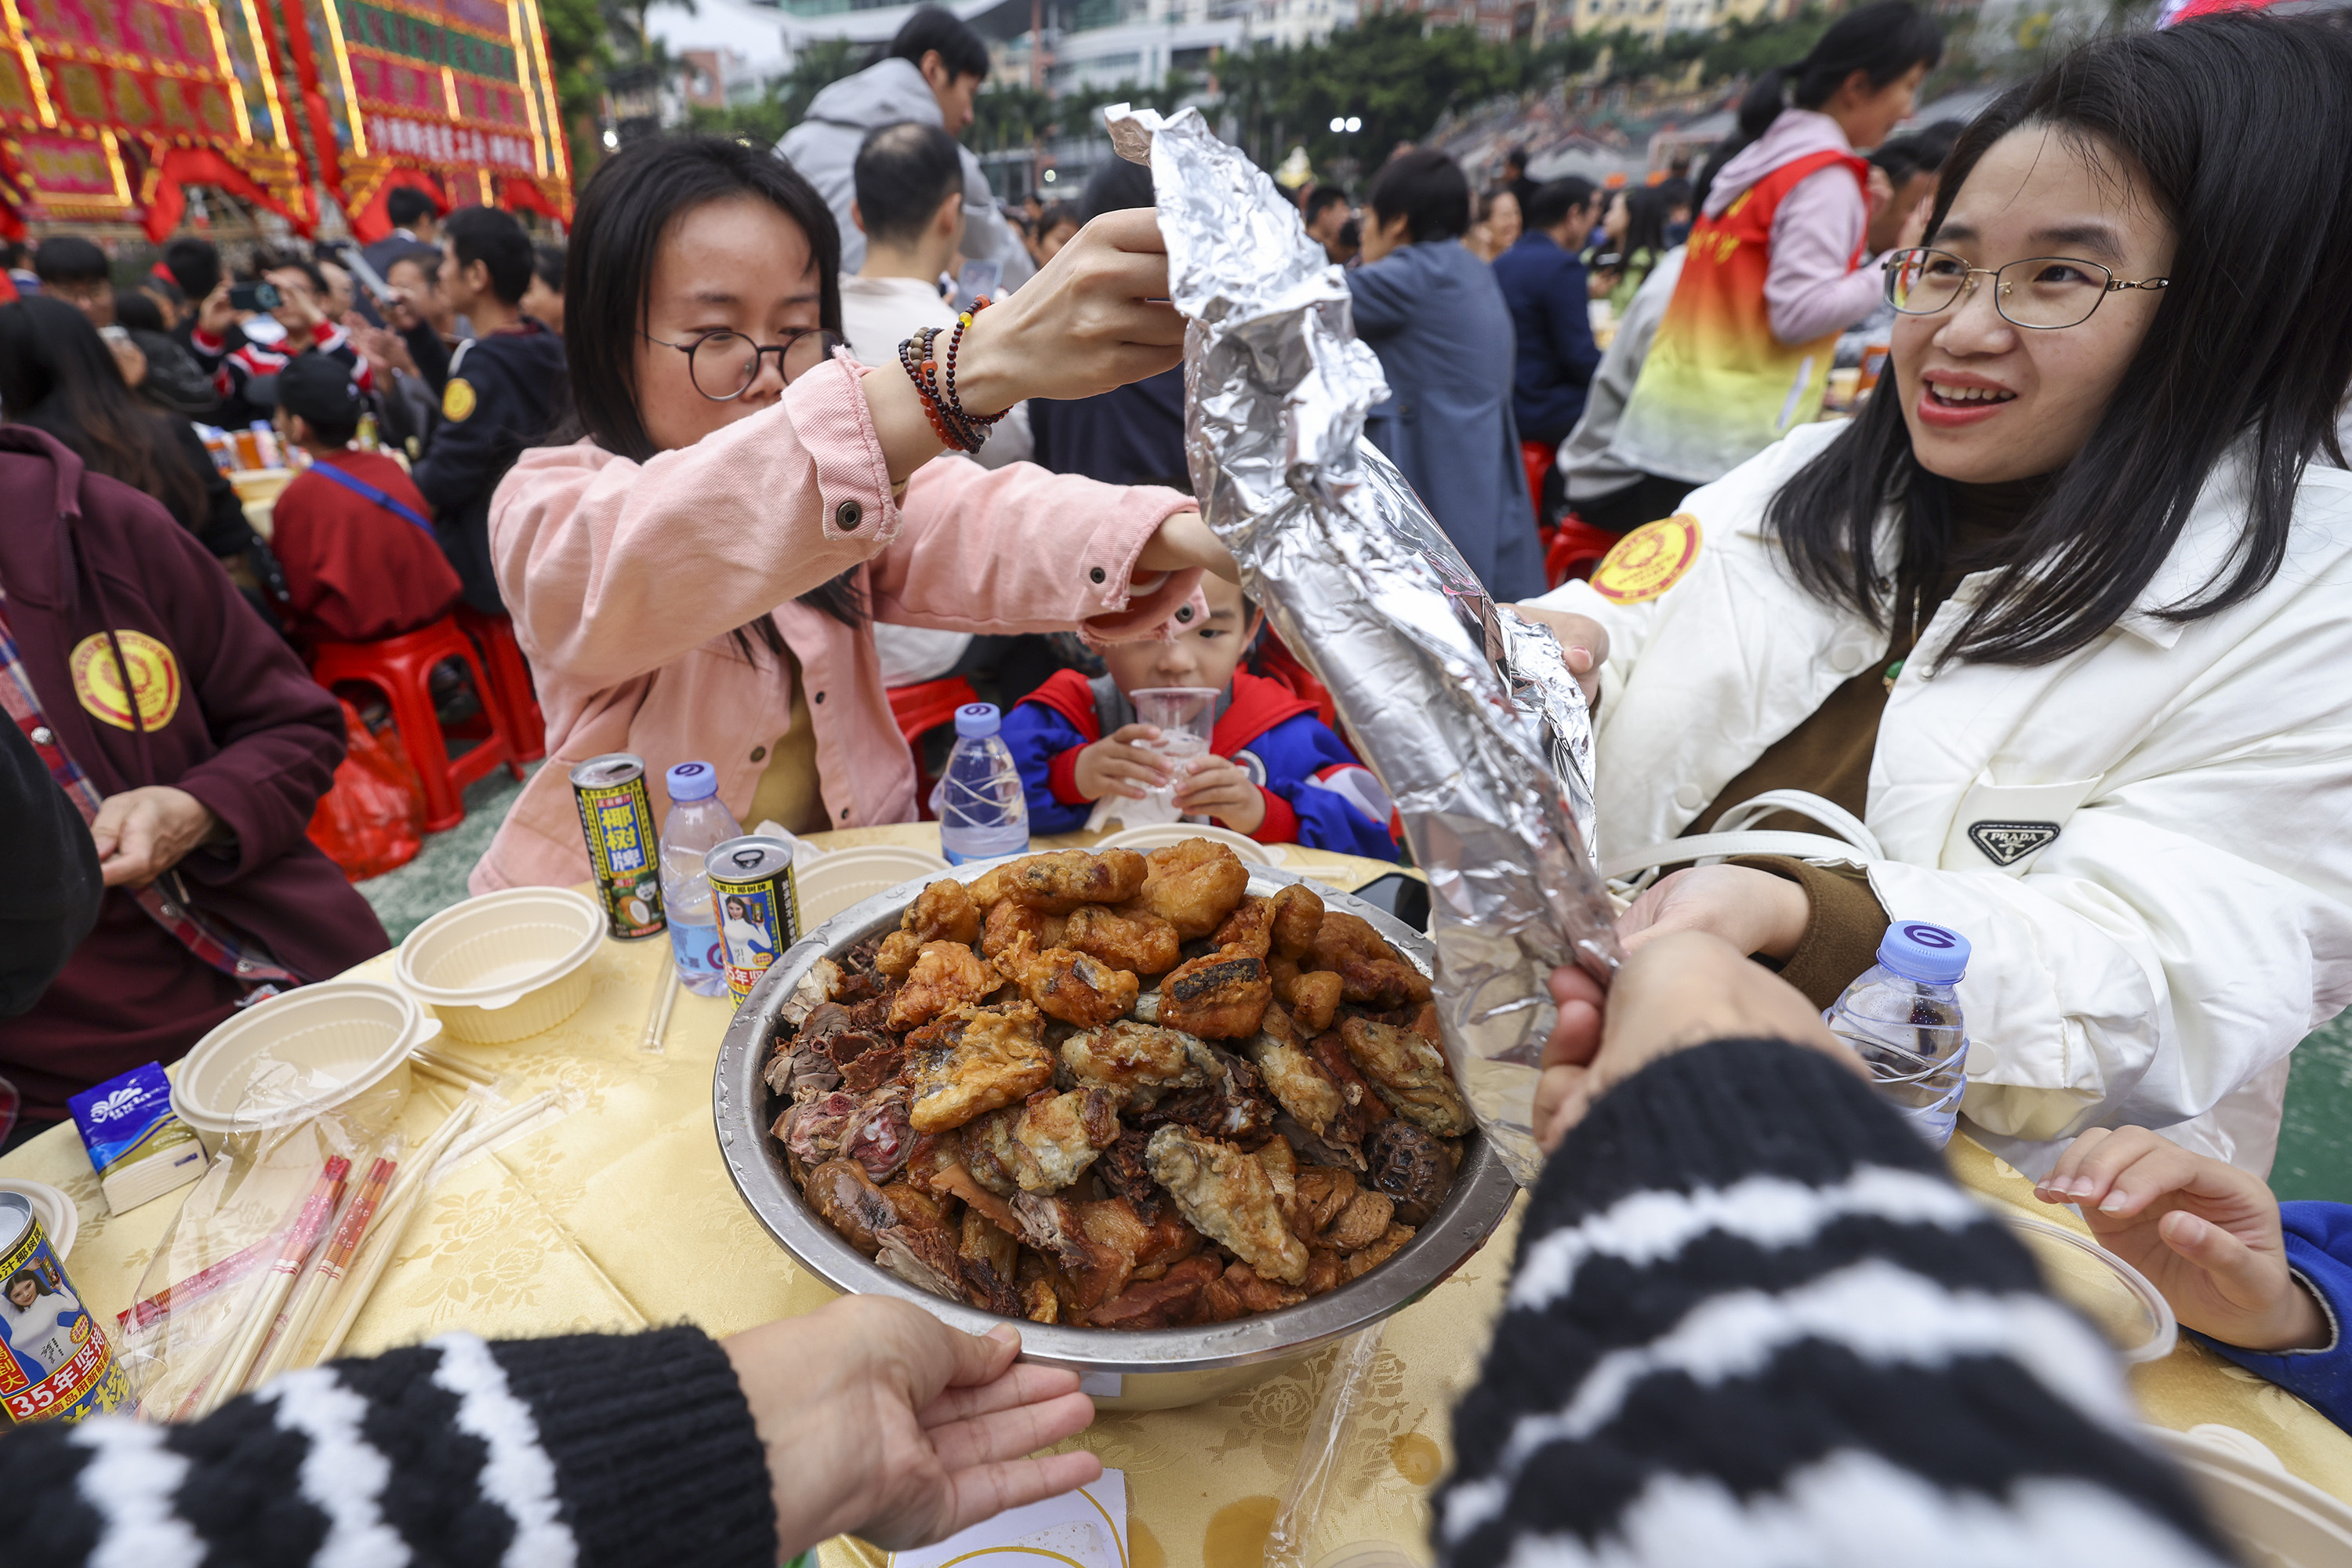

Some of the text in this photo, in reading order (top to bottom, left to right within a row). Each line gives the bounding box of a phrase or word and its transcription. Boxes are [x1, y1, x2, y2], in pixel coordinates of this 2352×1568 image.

[601, 804, 641, 872] 椰树牌
[1989, 833, 2038, 841] PRADA
[0, 1227, 42, 1279] 汁椰树牌
[12, 1327, 105, 1417] 35年坚持
